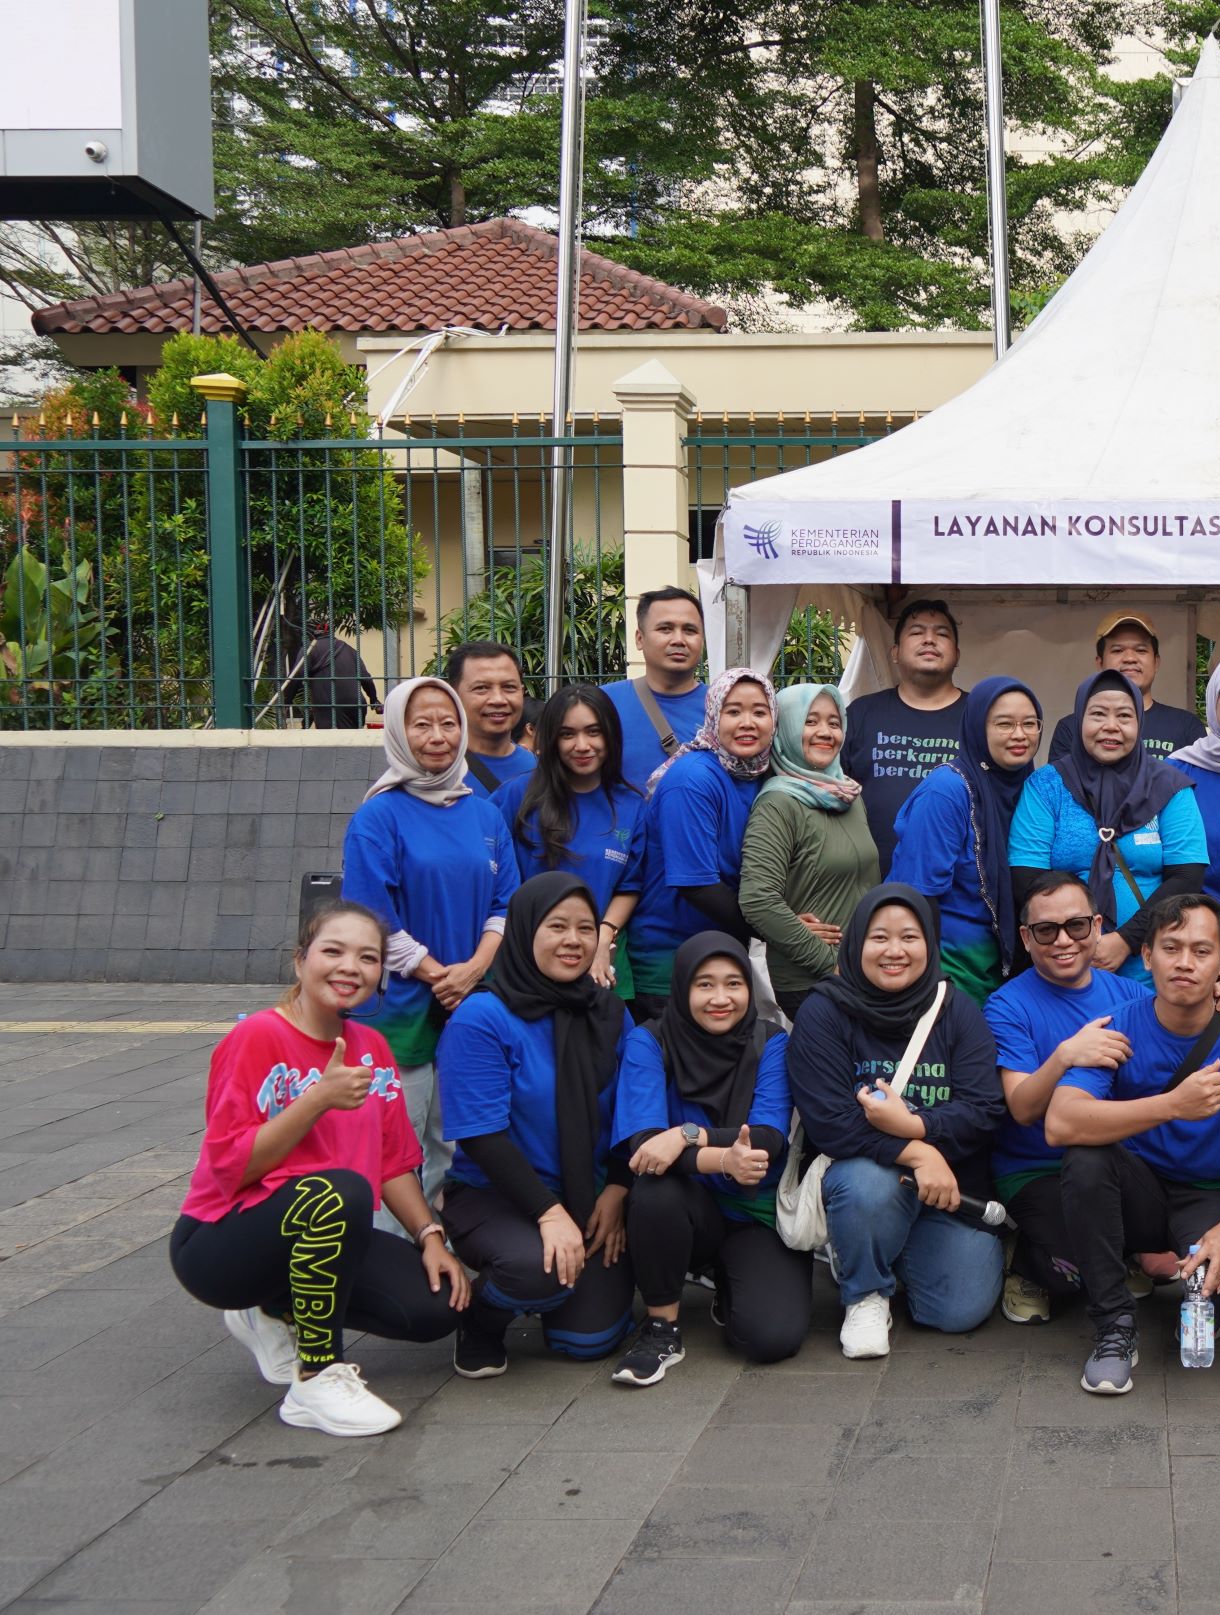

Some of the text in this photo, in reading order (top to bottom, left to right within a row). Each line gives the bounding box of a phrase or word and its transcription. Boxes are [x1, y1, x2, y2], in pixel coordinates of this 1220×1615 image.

[791, 528, 879, 539] KEMENTERIAN
[933, 515, 1057, 537] LAYANAN
[791, 538, 879, 549] PERDAGANGAN
[281, 1176, 347, 1348] ZUMBA
